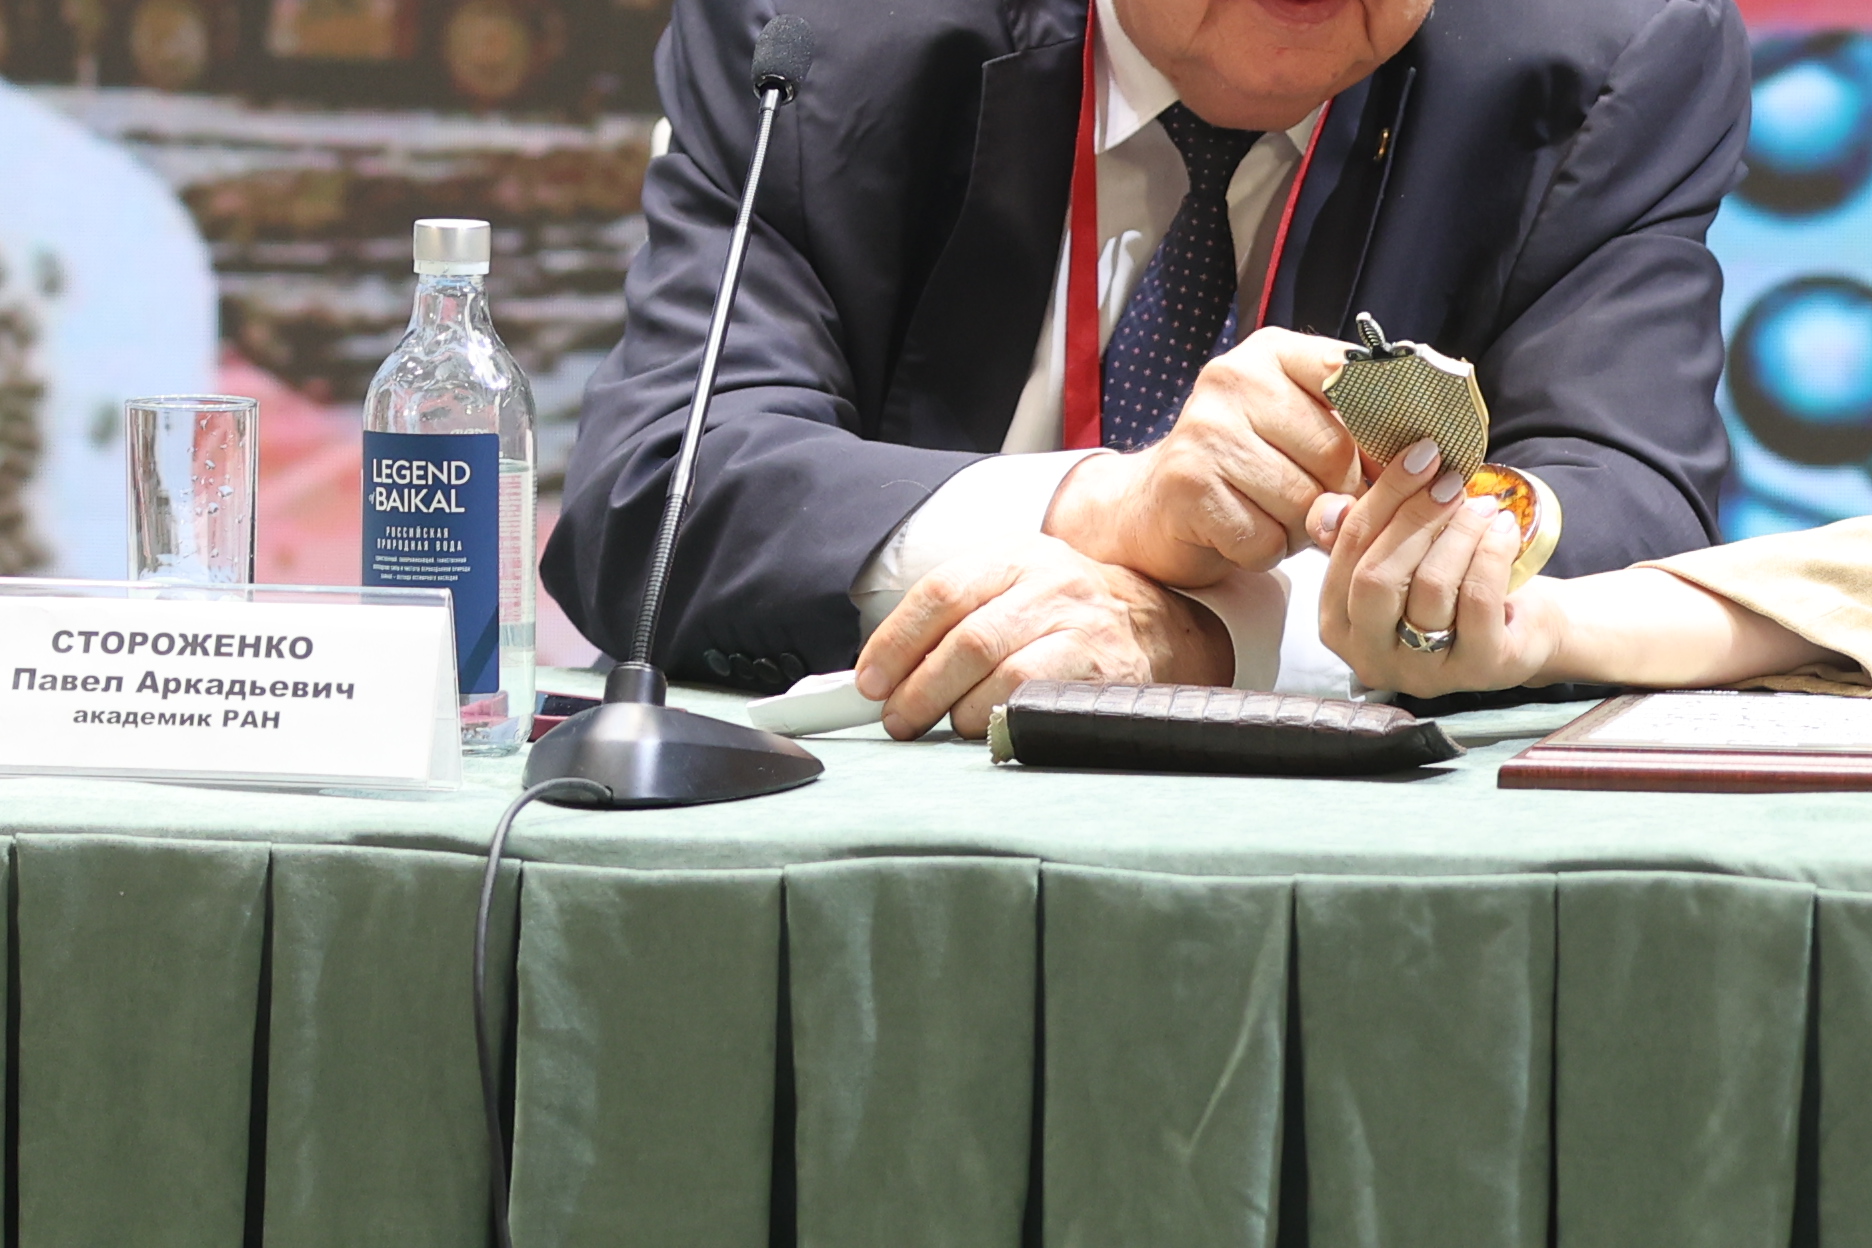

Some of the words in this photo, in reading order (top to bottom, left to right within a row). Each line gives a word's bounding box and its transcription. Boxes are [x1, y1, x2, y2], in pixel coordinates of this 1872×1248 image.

[372, 458, 471, 485] LEGEND
[375, 487, 466, 513] BAIKAL
[385, 525, 449, 539] РОССИЙСКАЯ
[377, 538, 429, 551] ПРИРОДНАЯ
[435, 540, 462, 553] ВОДА
[51, 629, 314, 660] СТОРОЖЕНКО
[12, 667, 124, 692] Павел
[135, 670, 355, 700] Аркадьевич
[73, 709, 212, 729] академик
[222, 709, 281, 730] РАН
